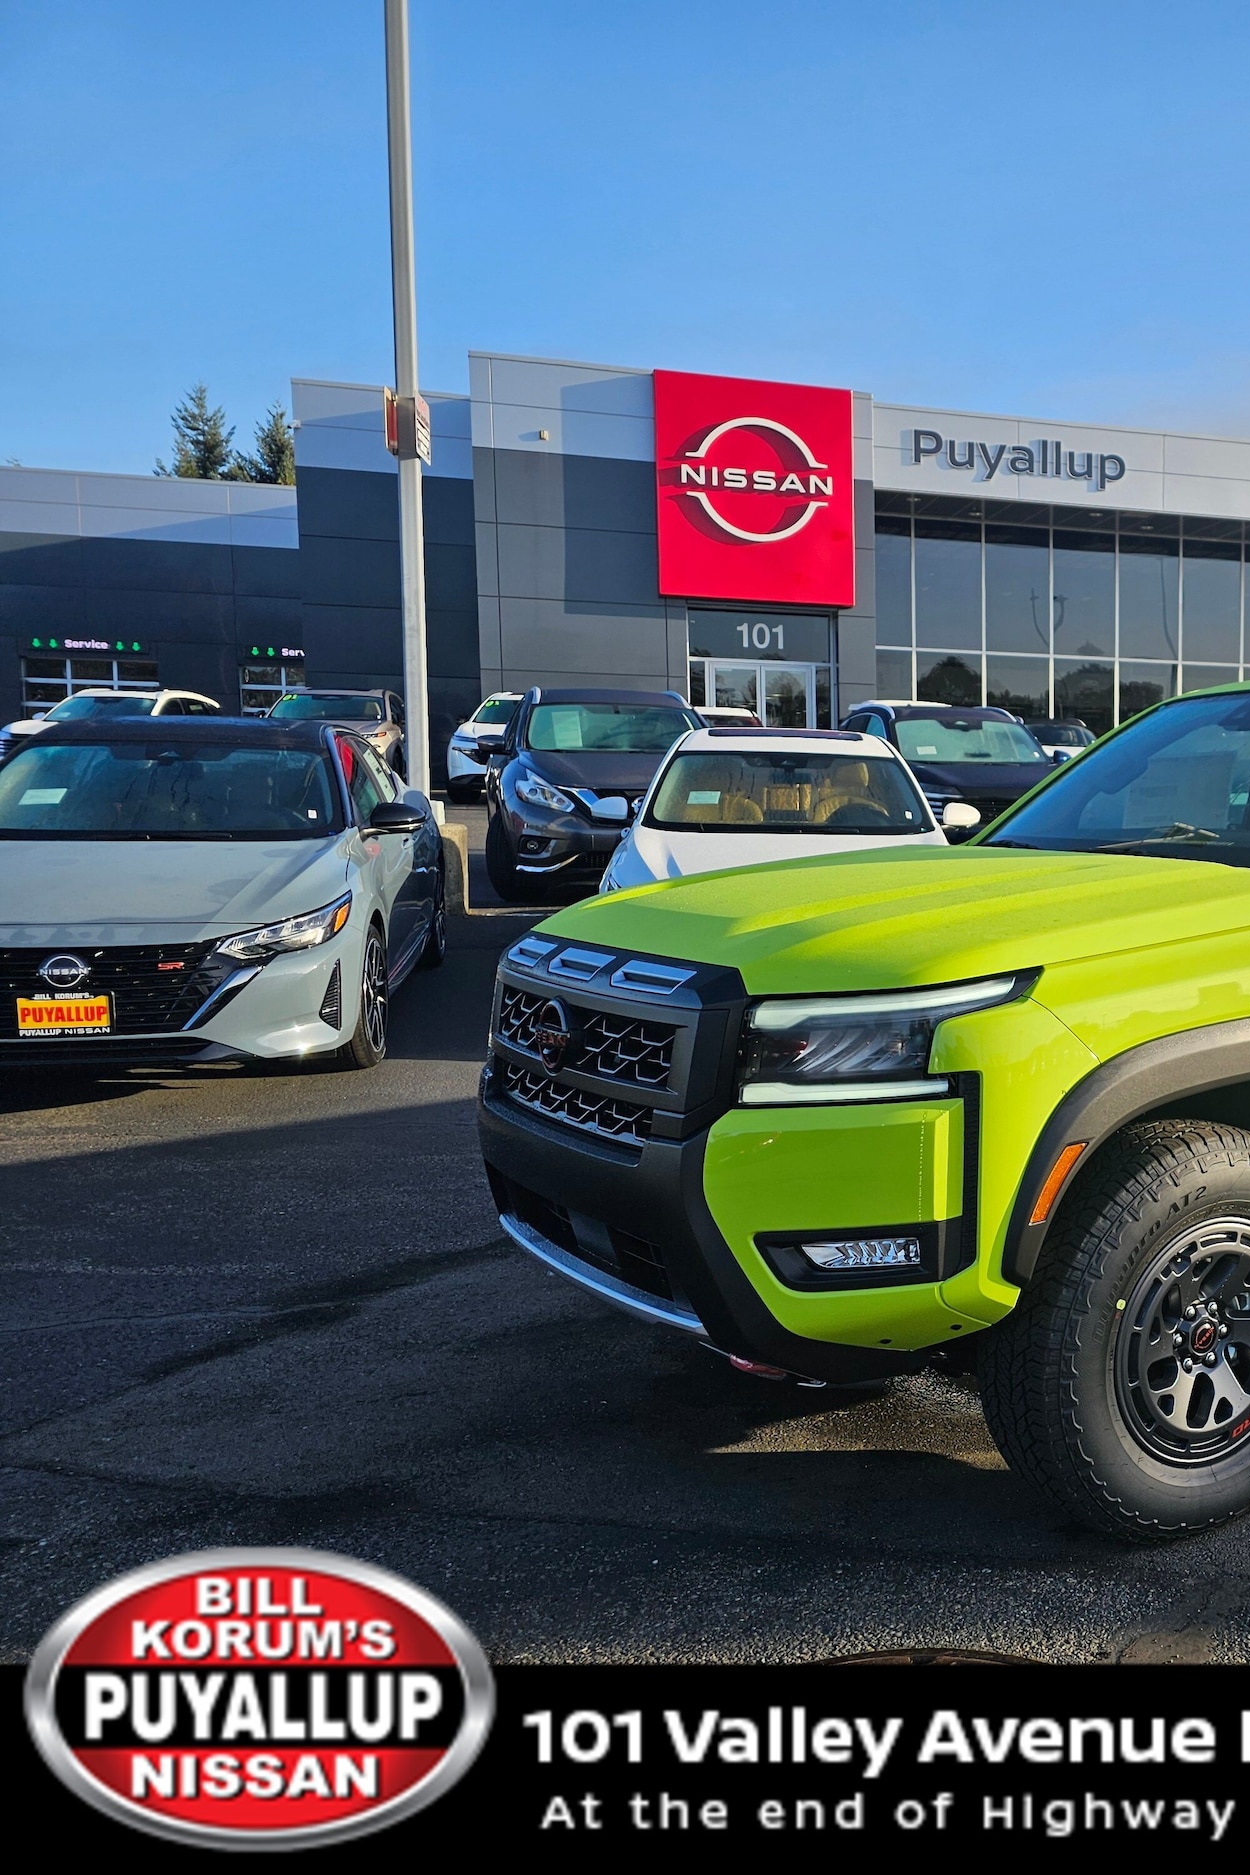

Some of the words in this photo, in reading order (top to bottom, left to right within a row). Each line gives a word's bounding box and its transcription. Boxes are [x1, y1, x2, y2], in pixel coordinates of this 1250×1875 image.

[912, 429, 1126, 491] Puyallup
[681, 463, 833, 495] NISSAN
[736, 622, 784, 650] 101
[64, 639, 108, 650] Service
[39, 967, 89, 976] NISSAN
[157, 961, 185, 971] SR
[33, 992, 52, 1001] BILL
[20, 1005, 108, 1023] PUYALLUP
[19, 1028, 62, 1037] PUYALLUP
[64, 1026, 111, 1035] NISSAN
